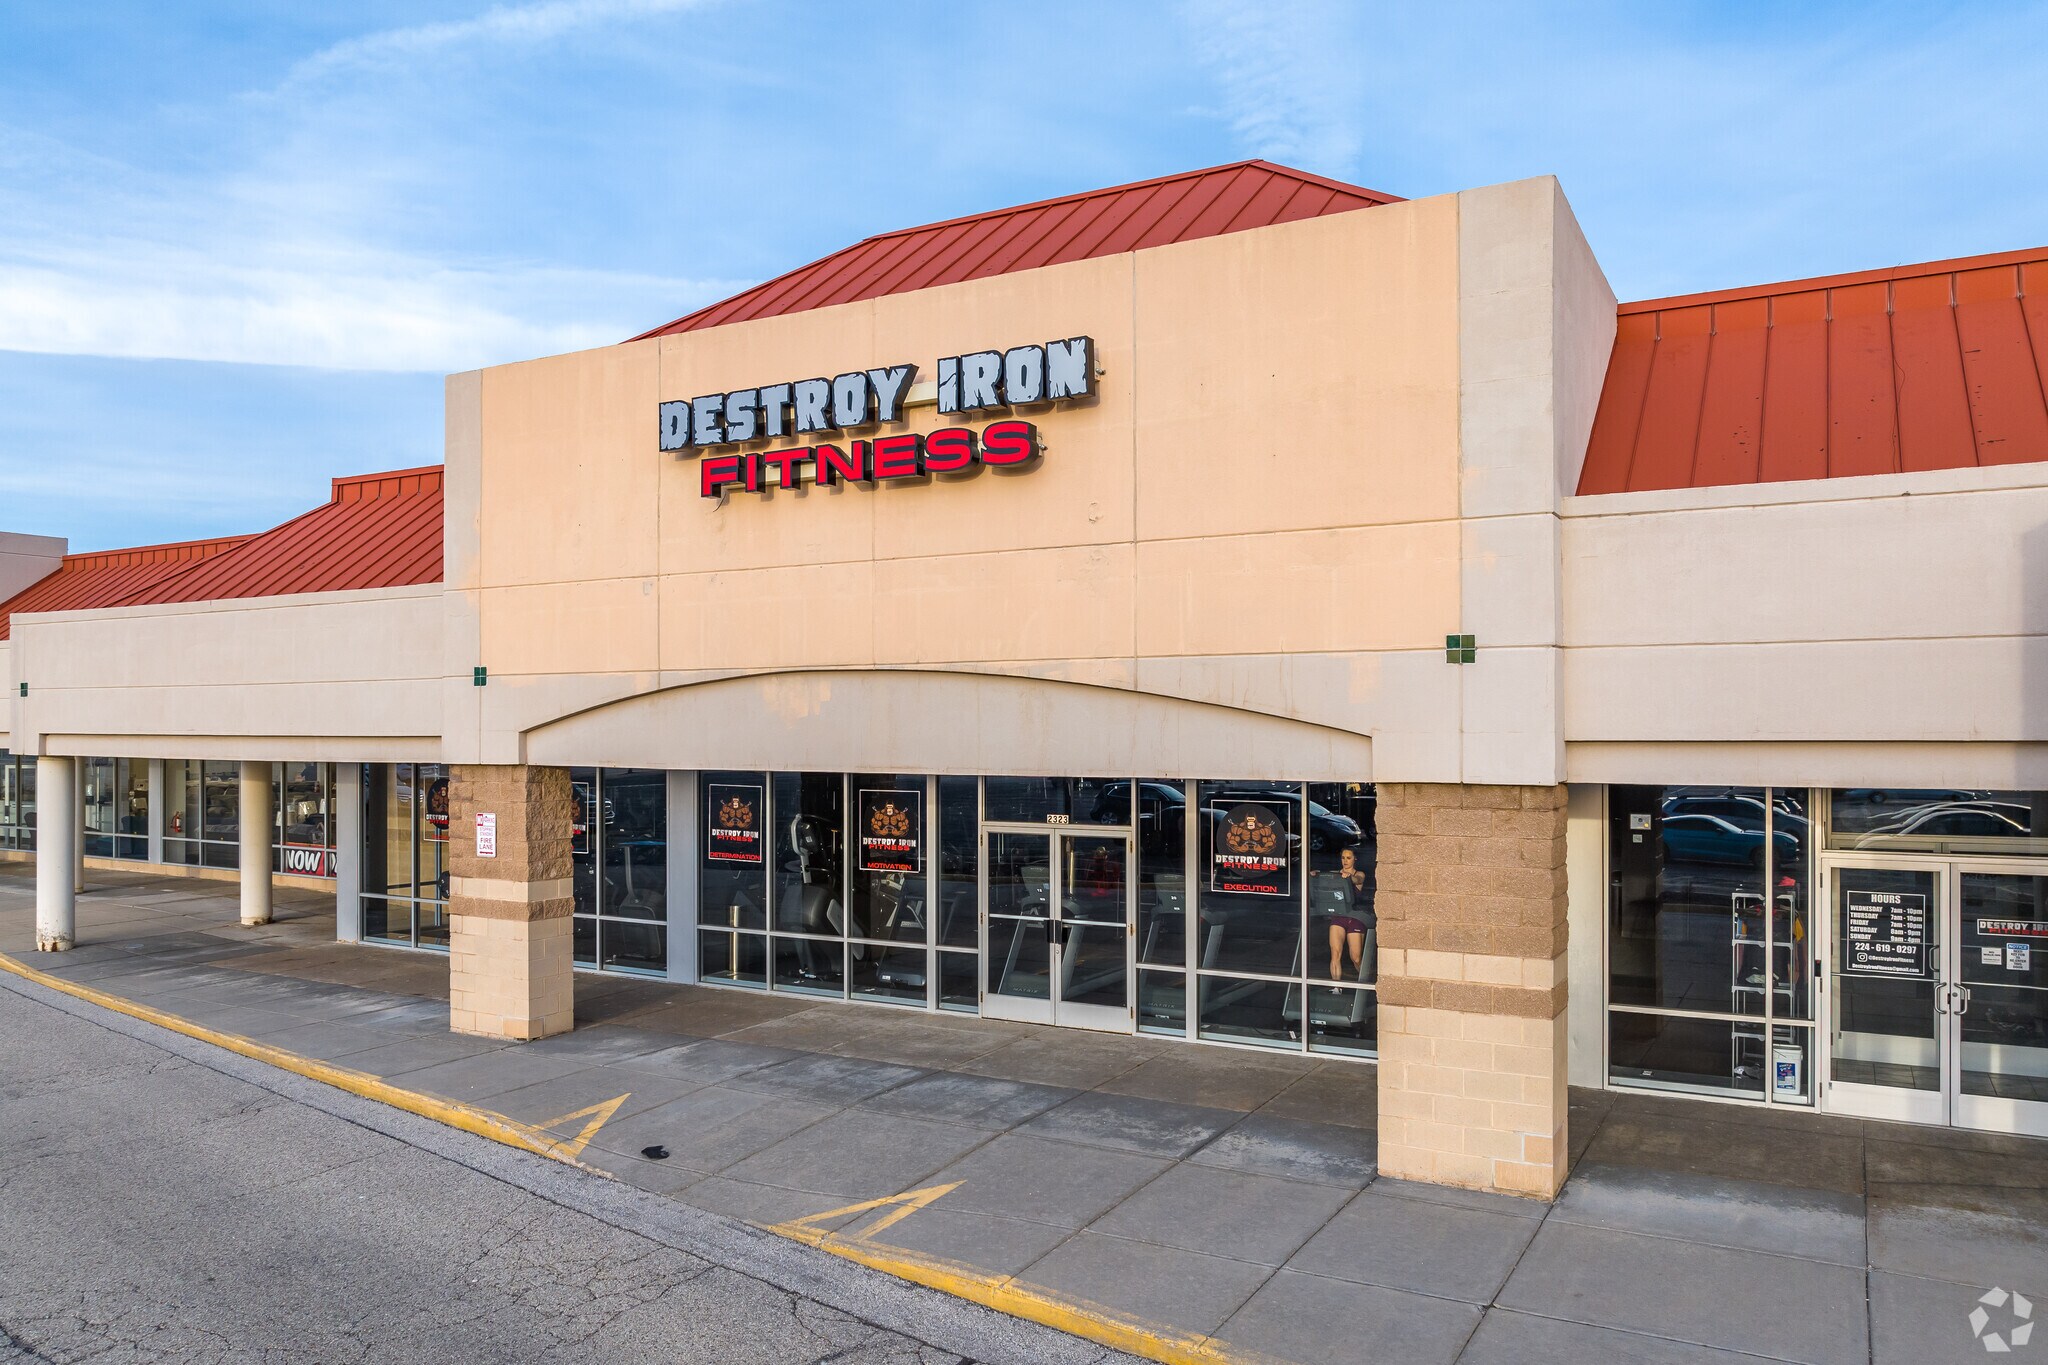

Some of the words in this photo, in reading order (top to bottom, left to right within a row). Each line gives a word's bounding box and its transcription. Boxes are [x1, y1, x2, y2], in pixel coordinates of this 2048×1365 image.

[659, 364, 918, 452] DESTROY
[937, 335, 1096, 415] IRON
[701, 420, 1038, 498] FITNESS
[1047, 815, 1069, 824] 2323
[712, 828, 741, 836] DESTROY
[743, 830, 759, 839] IRON
[717, 834, 753, 842] FITNESS
[862, 837, 896, 846] DESTROY
[898, 838, 917, 848] IRON
[868, 843, 910, 851] FITNESS
[287, 850, 321, 872] NOW
[710, 852, 761, 860] DETERMINATION
[1215, 854, 1260, 865] DESTROY
[1262, 856, 1286, 867] IRON
[867, 862, 912, 871] MOTIVATION
[1223, 861, 1278, 871] FITNESS
[1223, 883, 1278, 893] EXECUTION
[1871, 894, 1901, 903] HOURS
[1980, 921, 2029, 930] DESTROY
[1855, 942, 1870, 951] 224
[1876, 943, 1891, 952] 619
[1896, 944, 1917, 954] 0297
